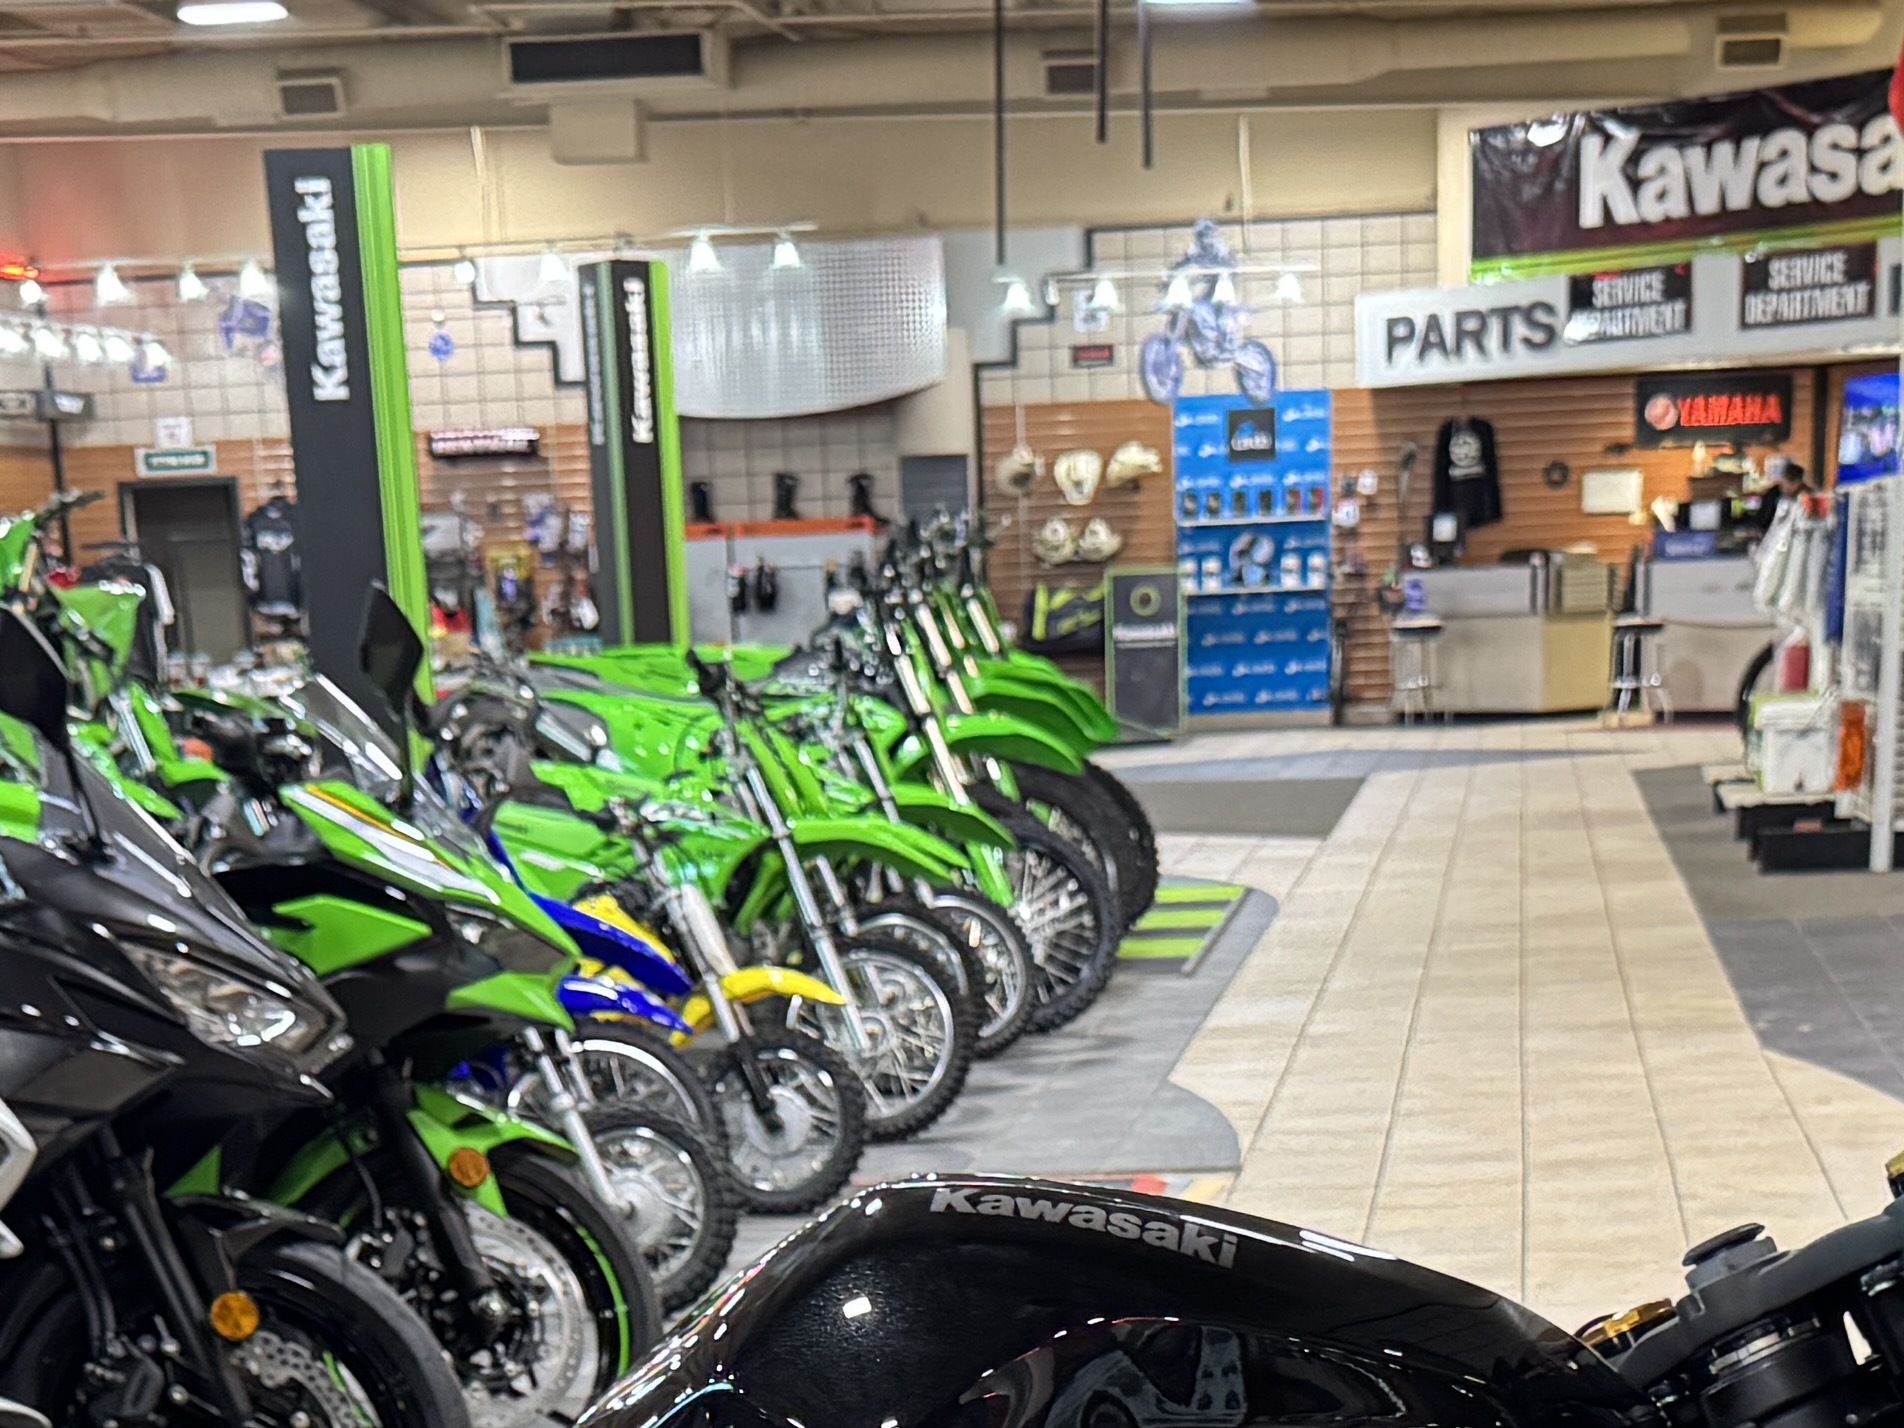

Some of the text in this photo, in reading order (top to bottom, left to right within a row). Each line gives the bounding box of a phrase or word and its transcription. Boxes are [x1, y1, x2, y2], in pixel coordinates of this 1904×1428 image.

[294, 176, 350, 401] Kawasaki
[1591, 269, 1667, 309] SERVICE
[1767, 251, 1848, 291] SERVICE
[1743, 280, 1872, 325] DEPARTMENT
[1385, 301, 1558, 366] PARTS
[1680, 394, 1783, 427] YAMAHA
[929, 1187, 1238, 1269] Kawasaki
